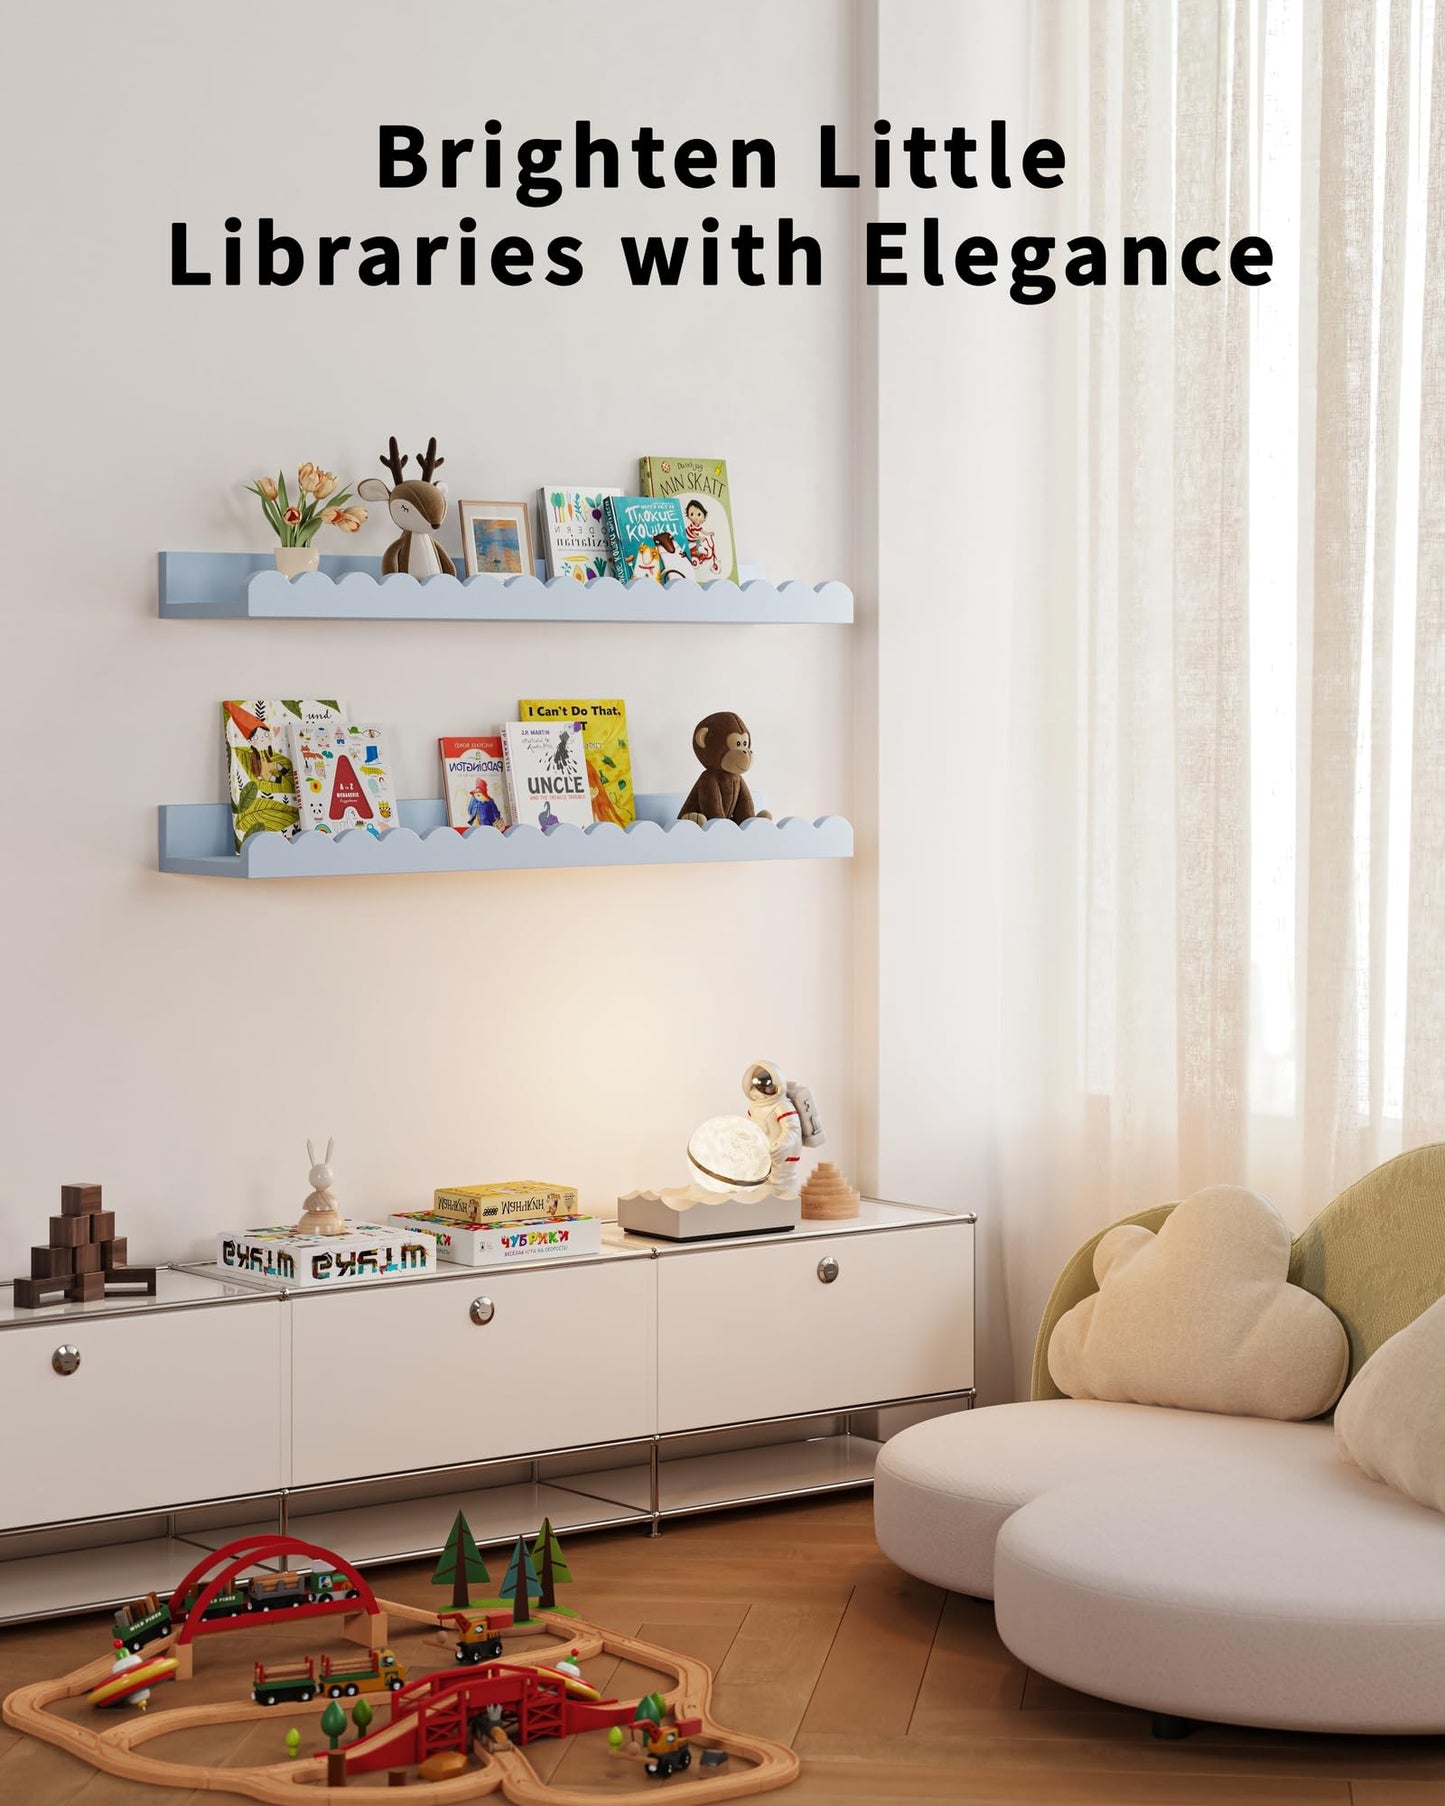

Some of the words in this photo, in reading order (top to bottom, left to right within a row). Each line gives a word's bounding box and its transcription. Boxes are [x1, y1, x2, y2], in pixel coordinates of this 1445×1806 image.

[660, 474, 685, 498] MIN
[687, 472, 727, 498] SKATT
[625, 505, 679, 524] ПЛОХИЕ
[625, 522, 679, 543] КОШКИ
[305, 709, 332, 720] und
[528, 706, 533, 716] I
[537, 706, 568, 716] Can't
[571, 706, 588, 716] Do
[591, 706, 621, 717] That,
[340, 783, 345, 791] A
[527, 776, 585, 794] UNCLE
[501, 1229, 569, 1249] ЧУБРИКИ
